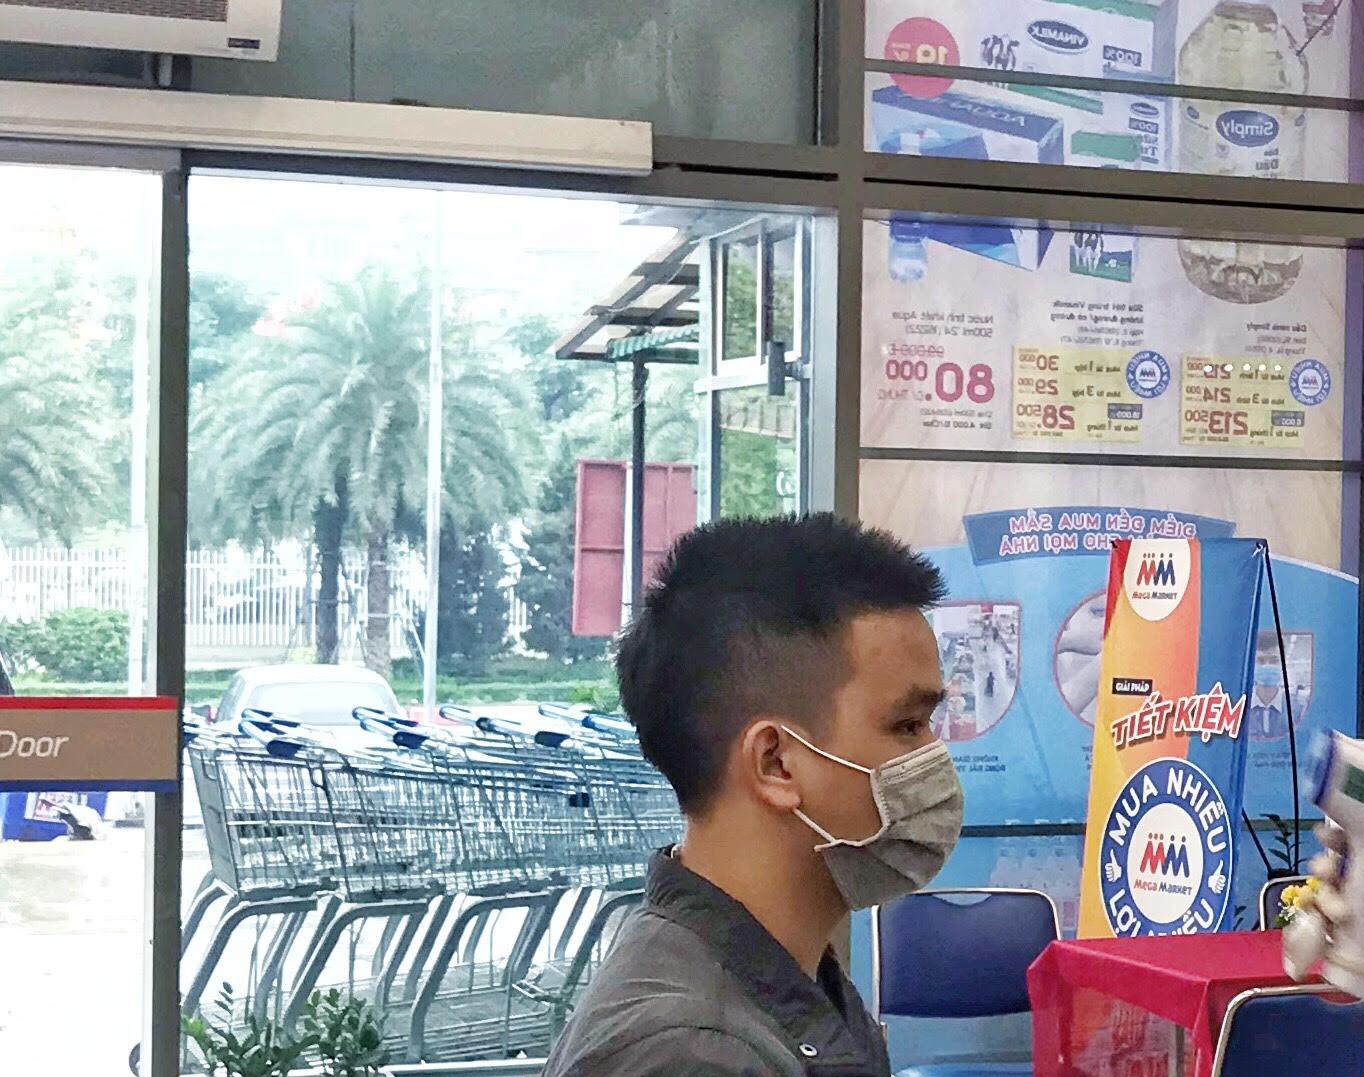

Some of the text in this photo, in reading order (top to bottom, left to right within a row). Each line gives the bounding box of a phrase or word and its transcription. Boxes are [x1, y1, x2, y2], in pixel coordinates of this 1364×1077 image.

[1115, 679, 1150, 692] GIẢI PHÁP
[1111, 681, 1247, 748] TIẾT KIỆM
[0, 730, 70, 758] Door
[1108, 767, 1228, 854] MUA NHIỀU
[1108, 888, 1142, 938] LỢI
